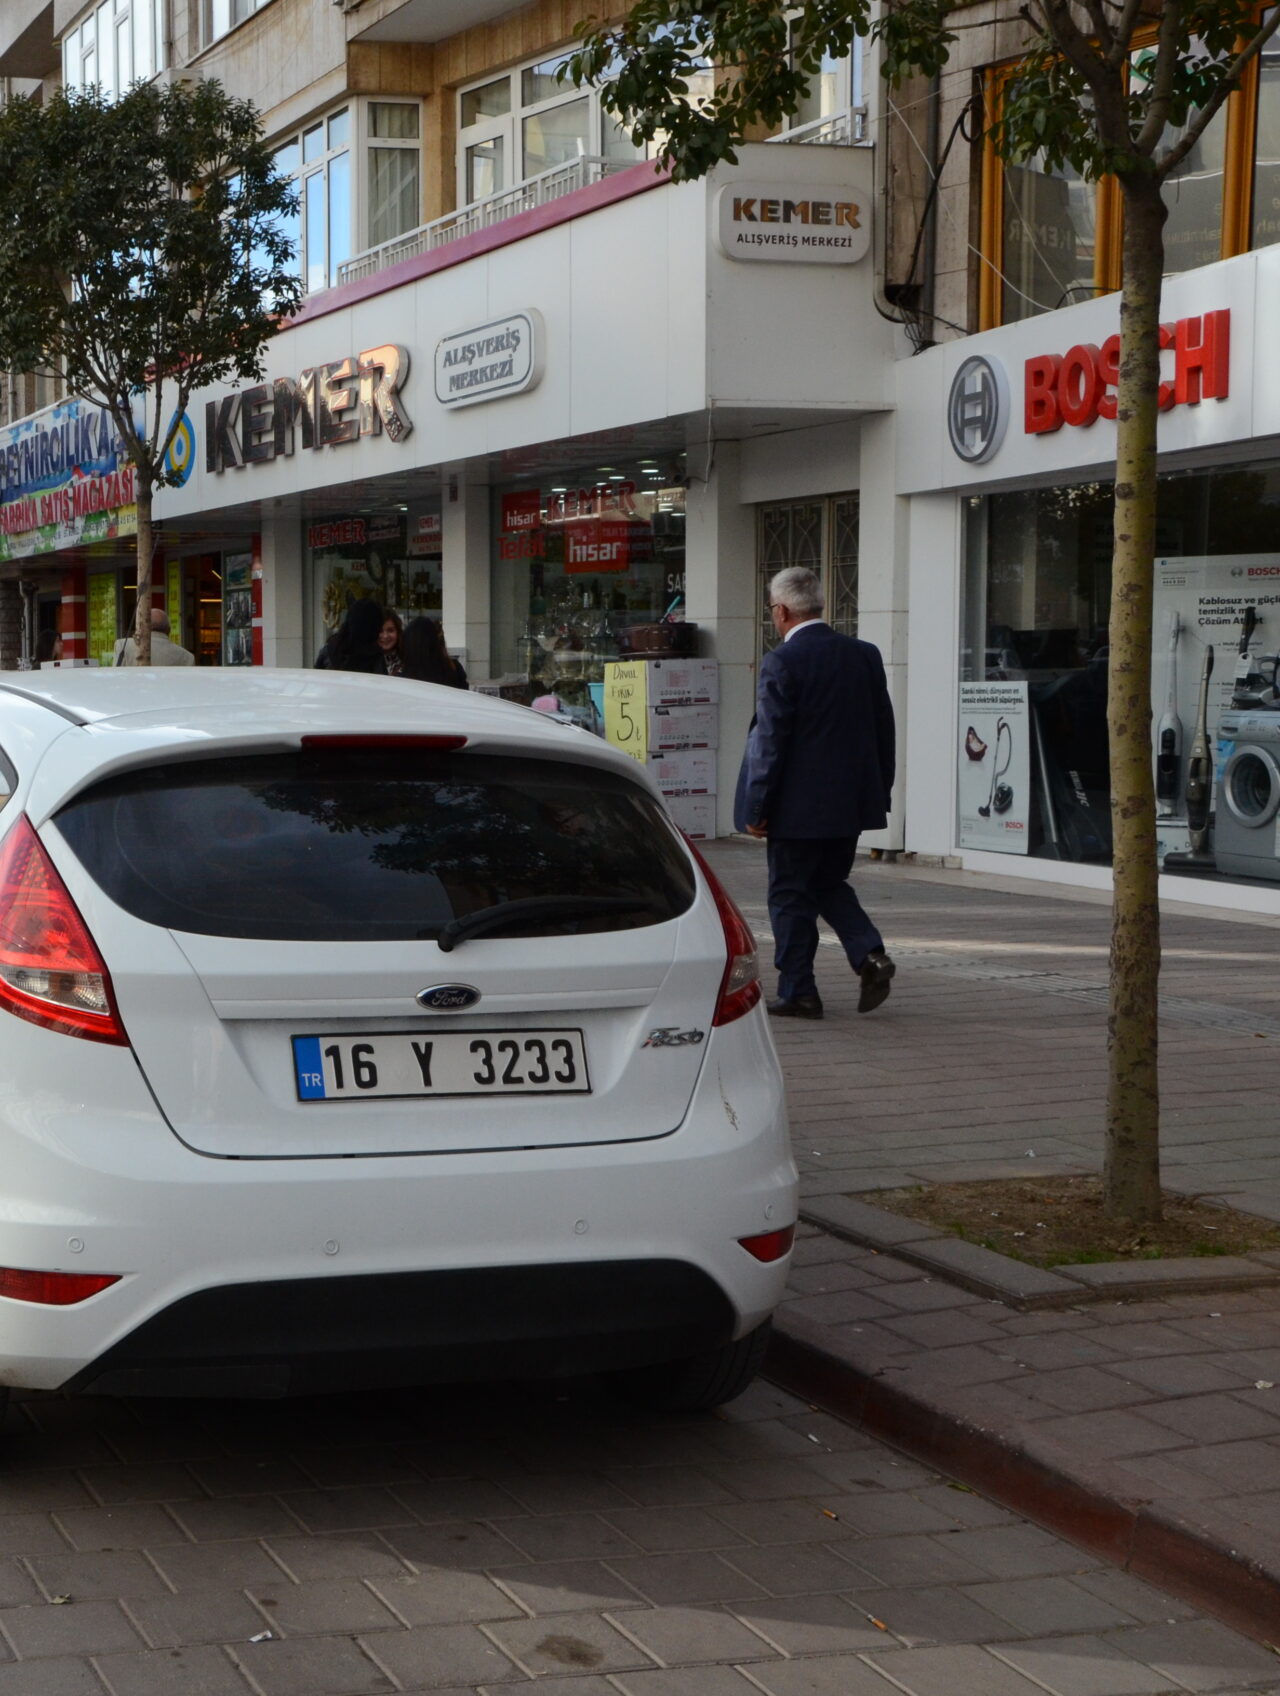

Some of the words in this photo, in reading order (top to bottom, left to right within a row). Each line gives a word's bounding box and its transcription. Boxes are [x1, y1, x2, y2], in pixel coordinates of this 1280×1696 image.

[733, 197, 862, 229] KEMER
[737, 233, 798, 248] ALIŞVERİŞ
[801, 235, 852, 248] MERKEZİ
[443, 327, 521, 369] ALIŞVERİŞ
[448, 353, 514, 393] MERKEZİ
[206, 343, 412, 475] KEMER
[545, 480, 637, 520] KEMER
[507, 509, 536, 527] hisar
[308, 518, 367, 549] KEMER
[569, 536, 622, 563] hisar
[1198, 597, 1242, 605] Kablosuz
[1198, 606, 1236, 615] temizlik
[1198, 616, 1231, 627] Çözüm
[617, 702, 634, 741] 5
[1005, 821, 1024, 829] BOSCH
[432, 989, 467, 1005] Ford
[301, 1072, 322, 1088] TR
[324, 1043, 378, 1090] 16
[411, 1042, 433, 1087] Y
[469, 1039, 577, 1086] 3233
